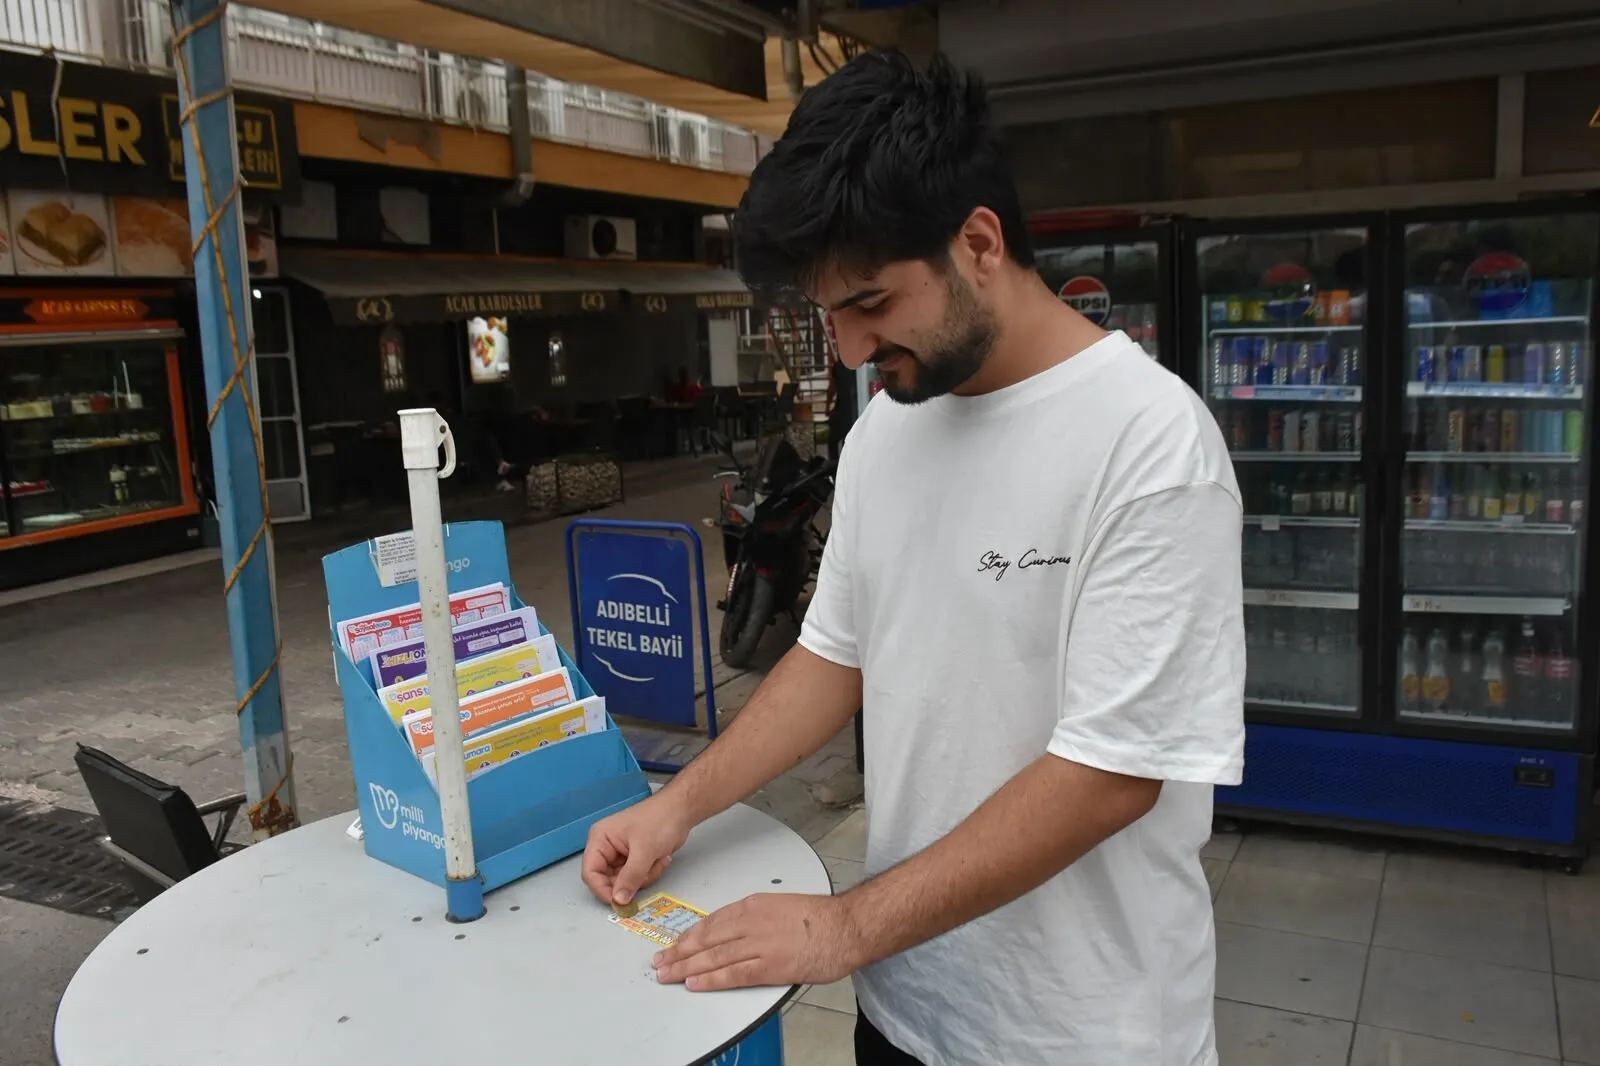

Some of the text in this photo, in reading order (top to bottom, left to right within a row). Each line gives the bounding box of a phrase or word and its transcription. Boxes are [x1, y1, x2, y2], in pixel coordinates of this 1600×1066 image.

[0, 90, 147, 166] LER
[978, 549, 1071, 581] Stay Curious
[596, 599, 670, 626] ADIBELLİ
[587, 627, 637, 651] TEKEL
[400, 806, 425, 824] milli
